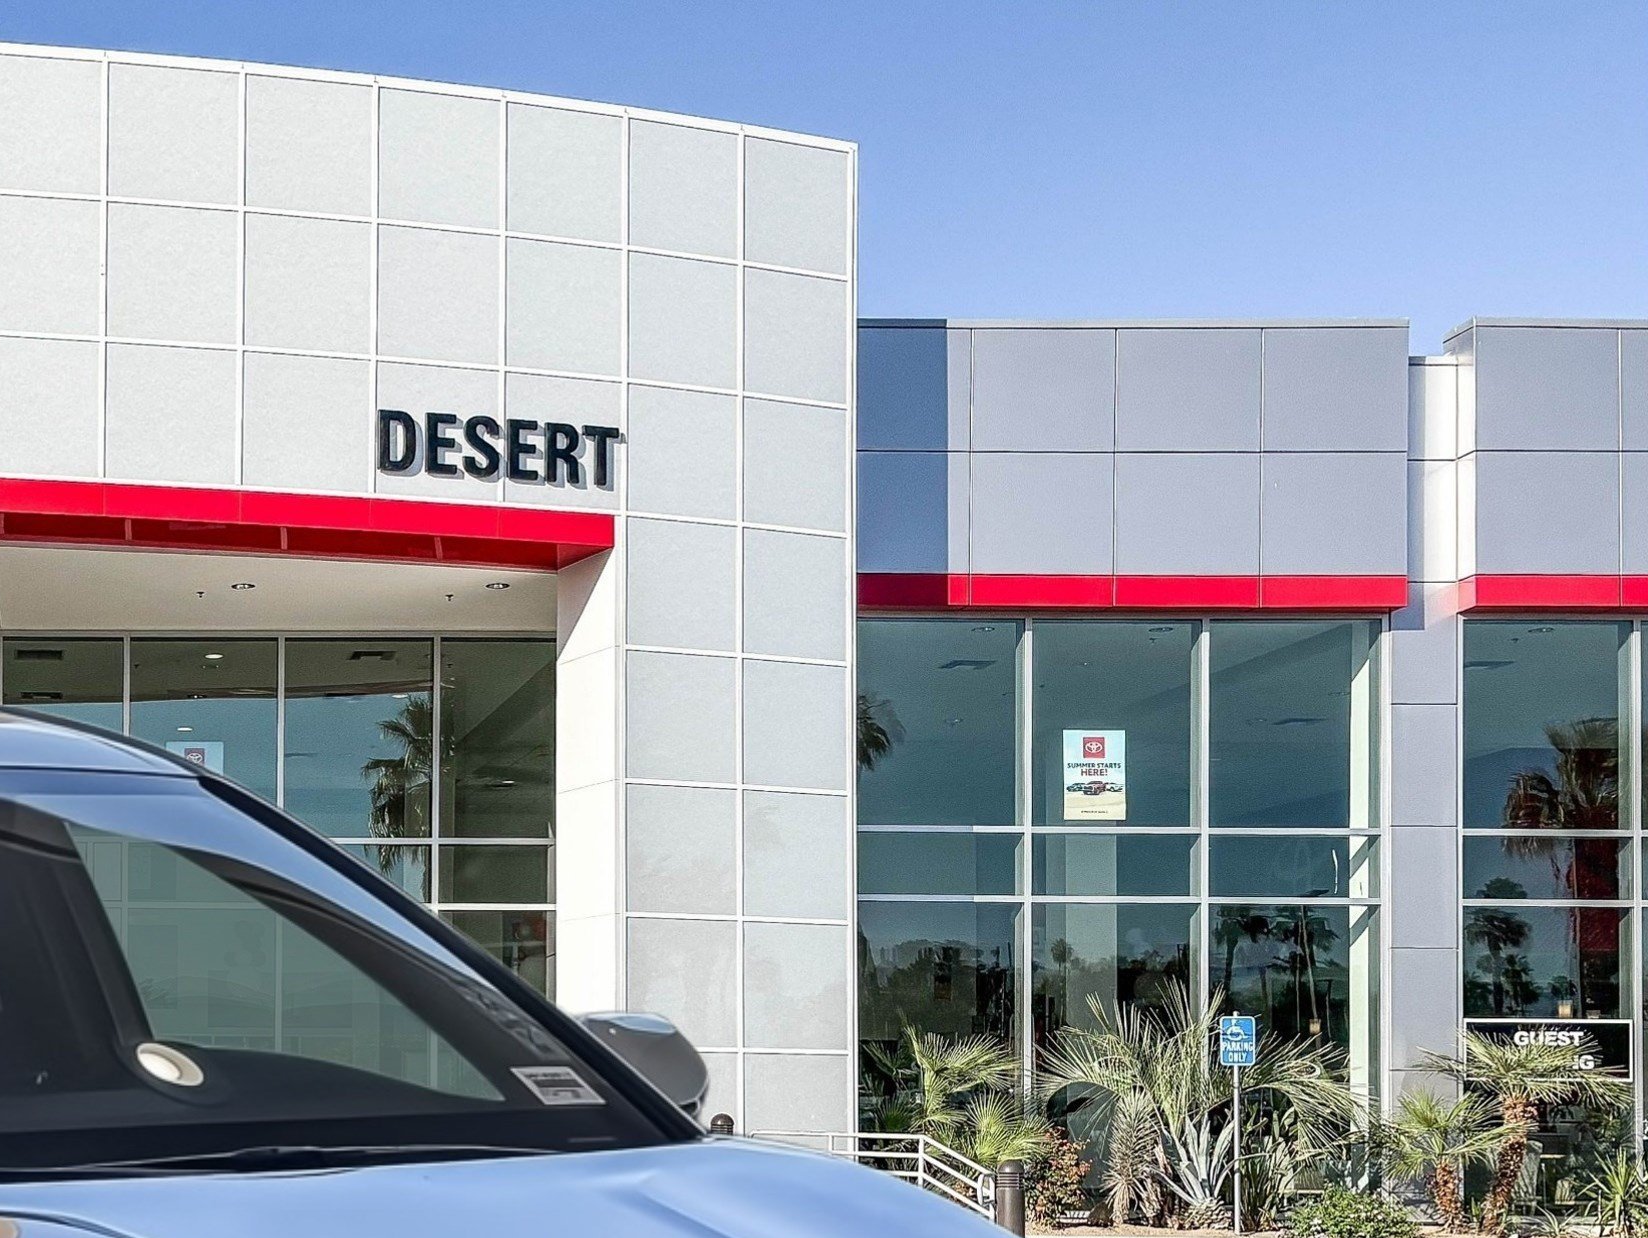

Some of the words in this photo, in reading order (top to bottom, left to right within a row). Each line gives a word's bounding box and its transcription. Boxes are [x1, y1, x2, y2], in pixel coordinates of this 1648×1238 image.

[377, 408, 620, 487] DESERT
[1080, 768, 1108, 776] HERE!
[1513, 1030, 1584, 1047] GUEST
[1222, 1041, 1254, 1052] PARKING
[1228, 1052, 1247, 1062] ONLY
